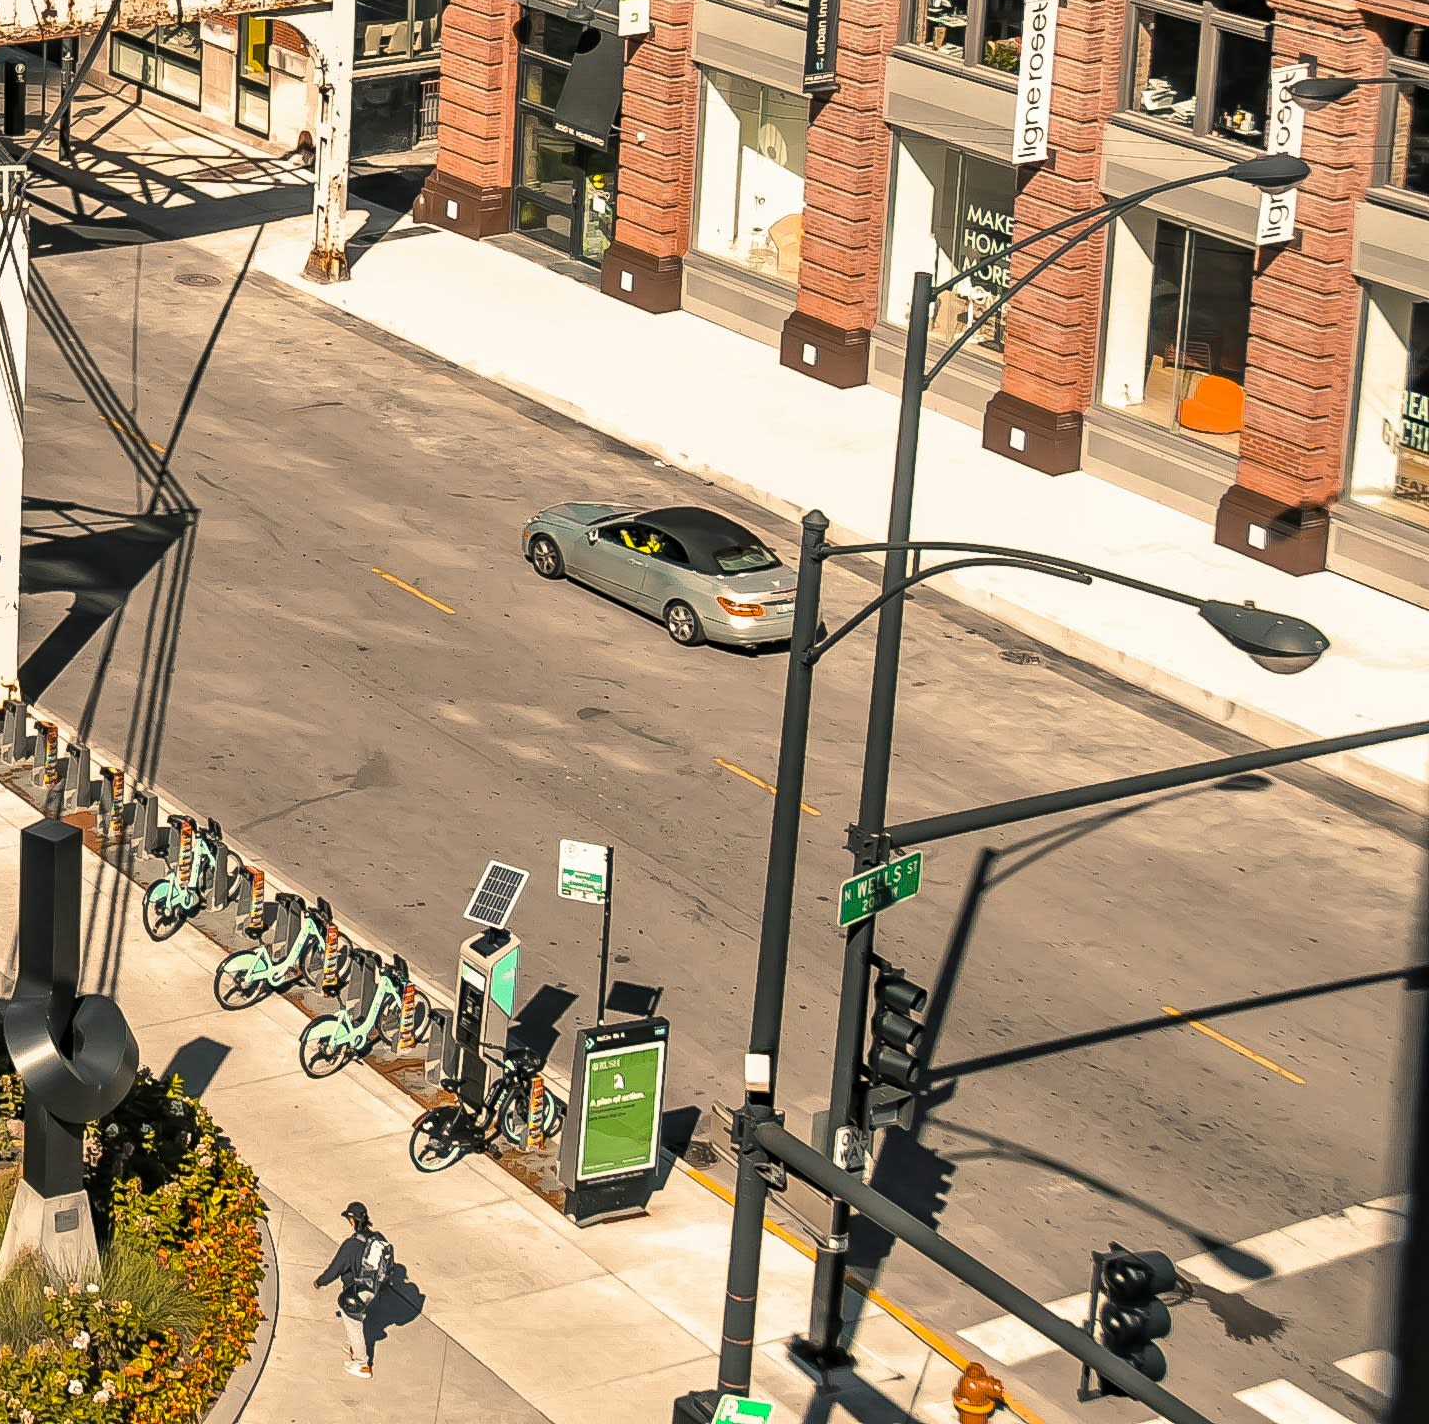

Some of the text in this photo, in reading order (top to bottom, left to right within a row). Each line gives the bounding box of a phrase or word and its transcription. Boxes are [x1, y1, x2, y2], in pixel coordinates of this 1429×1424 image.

[815, 21, 827, 55] urban
[1017, 1, 1049, 158] ligne roset
[1276, 71, 1297, 155] oset
[966, 204, 1015, 236] MAKE
[844, 860, 918, 902] N WELLS ST
[840, 1142, 869, 1163] WAY
